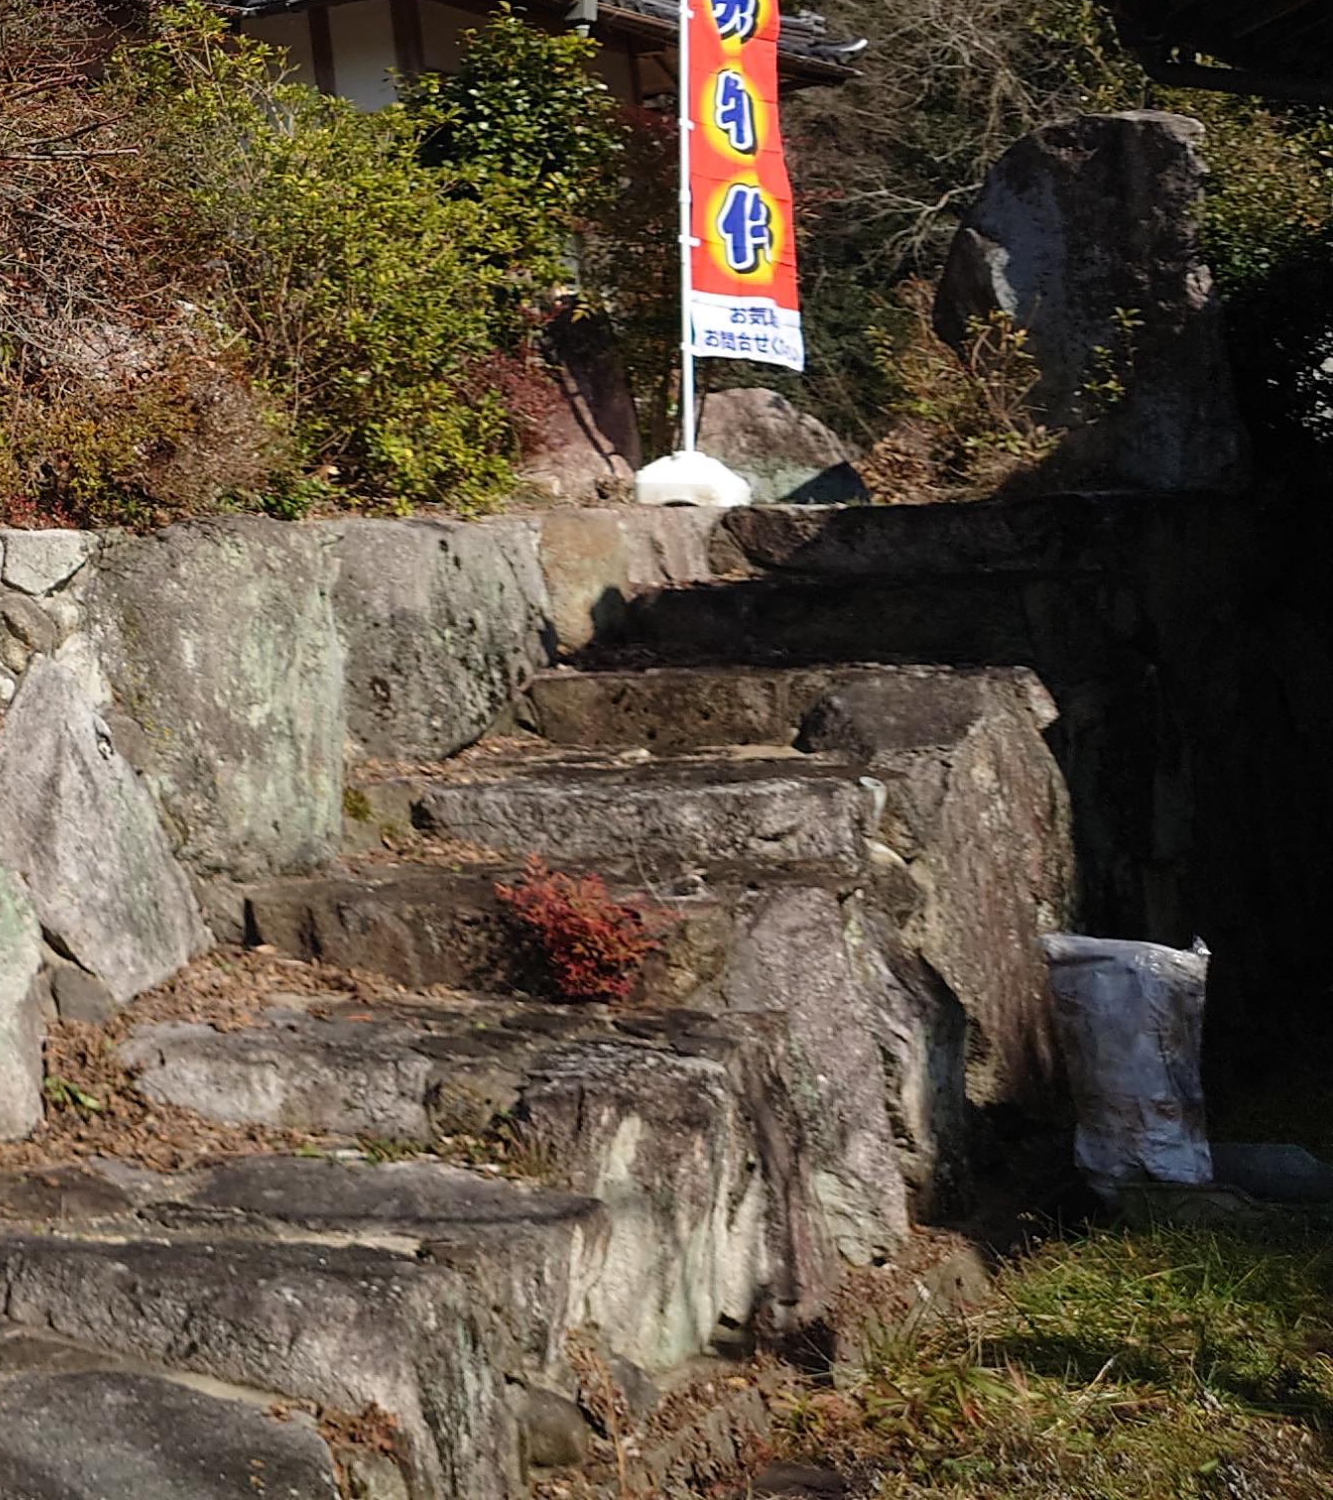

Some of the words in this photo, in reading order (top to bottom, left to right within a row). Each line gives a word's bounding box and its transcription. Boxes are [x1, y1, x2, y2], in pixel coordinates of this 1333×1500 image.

[704, 329, 800, 361] お問合せく
